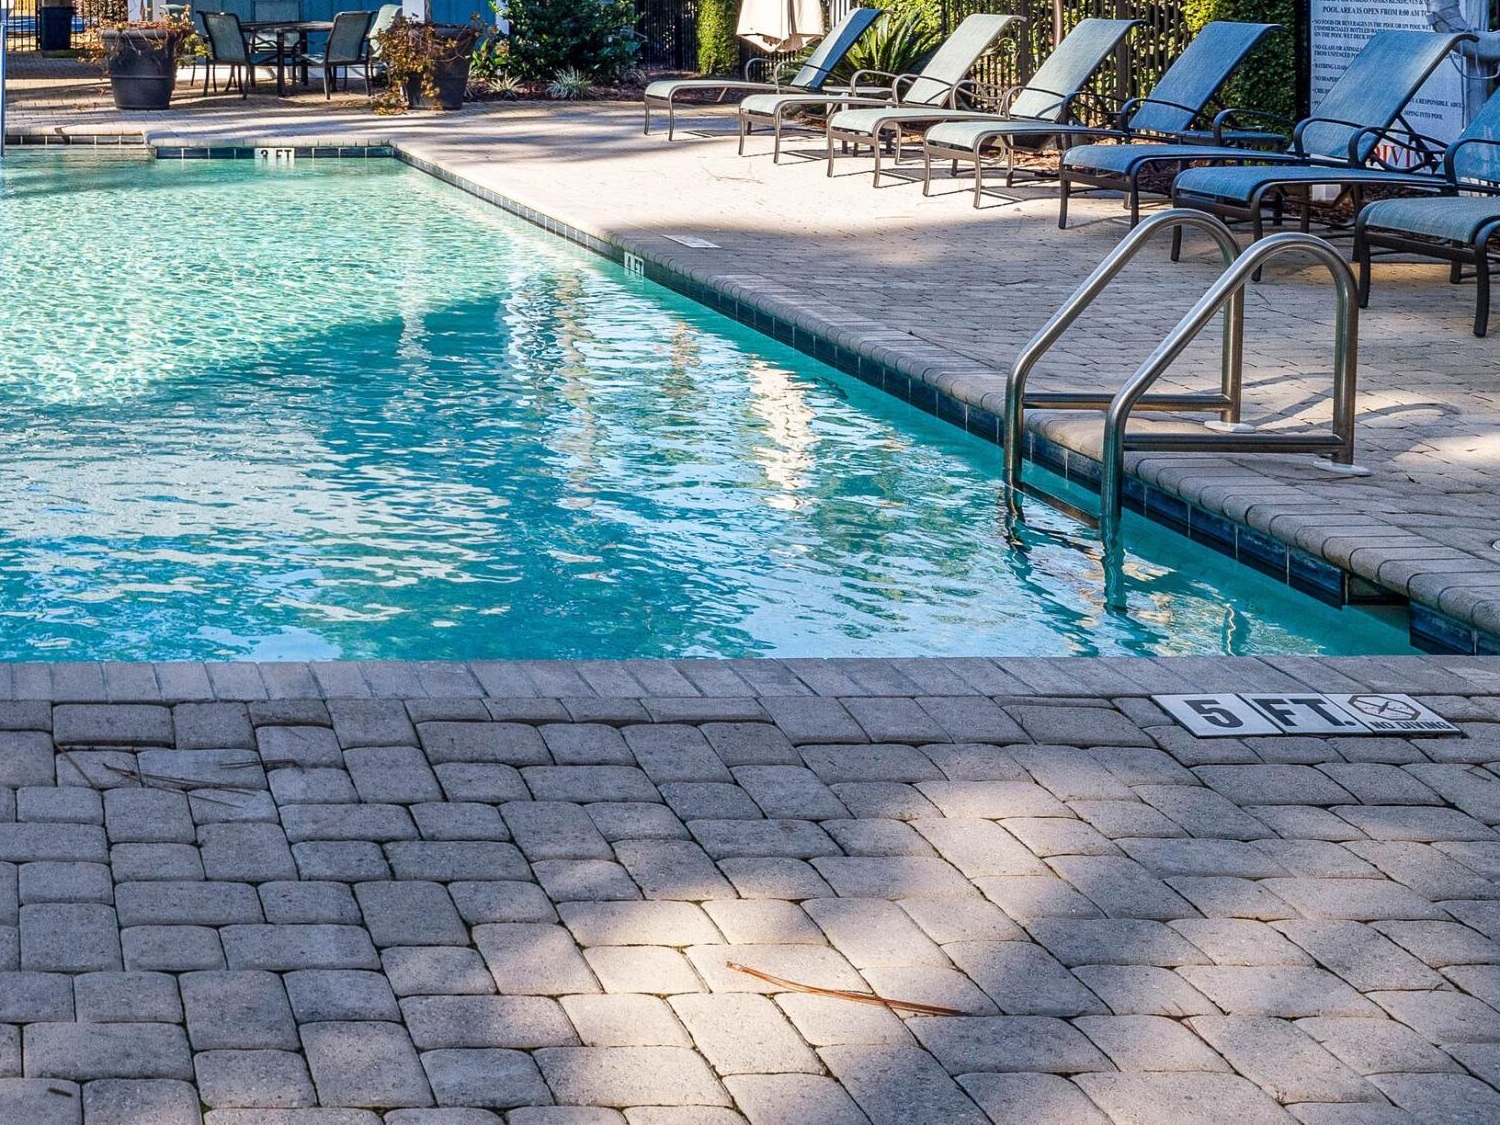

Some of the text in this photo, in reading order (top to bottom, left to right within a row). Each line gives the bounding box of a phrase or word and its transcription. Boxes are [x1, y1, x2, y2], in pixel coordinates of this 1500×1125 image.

[1339, 6, 1356, 14] AREA
[1363, 7, 1379, 15] OPEN
[1380, 8, 1398, 16] FROM
[275, 149, 292, 162] FT
[1183, 698, 1357, 728] 5 FT.
[1368, 721, 1451, 731] NO DIVING
